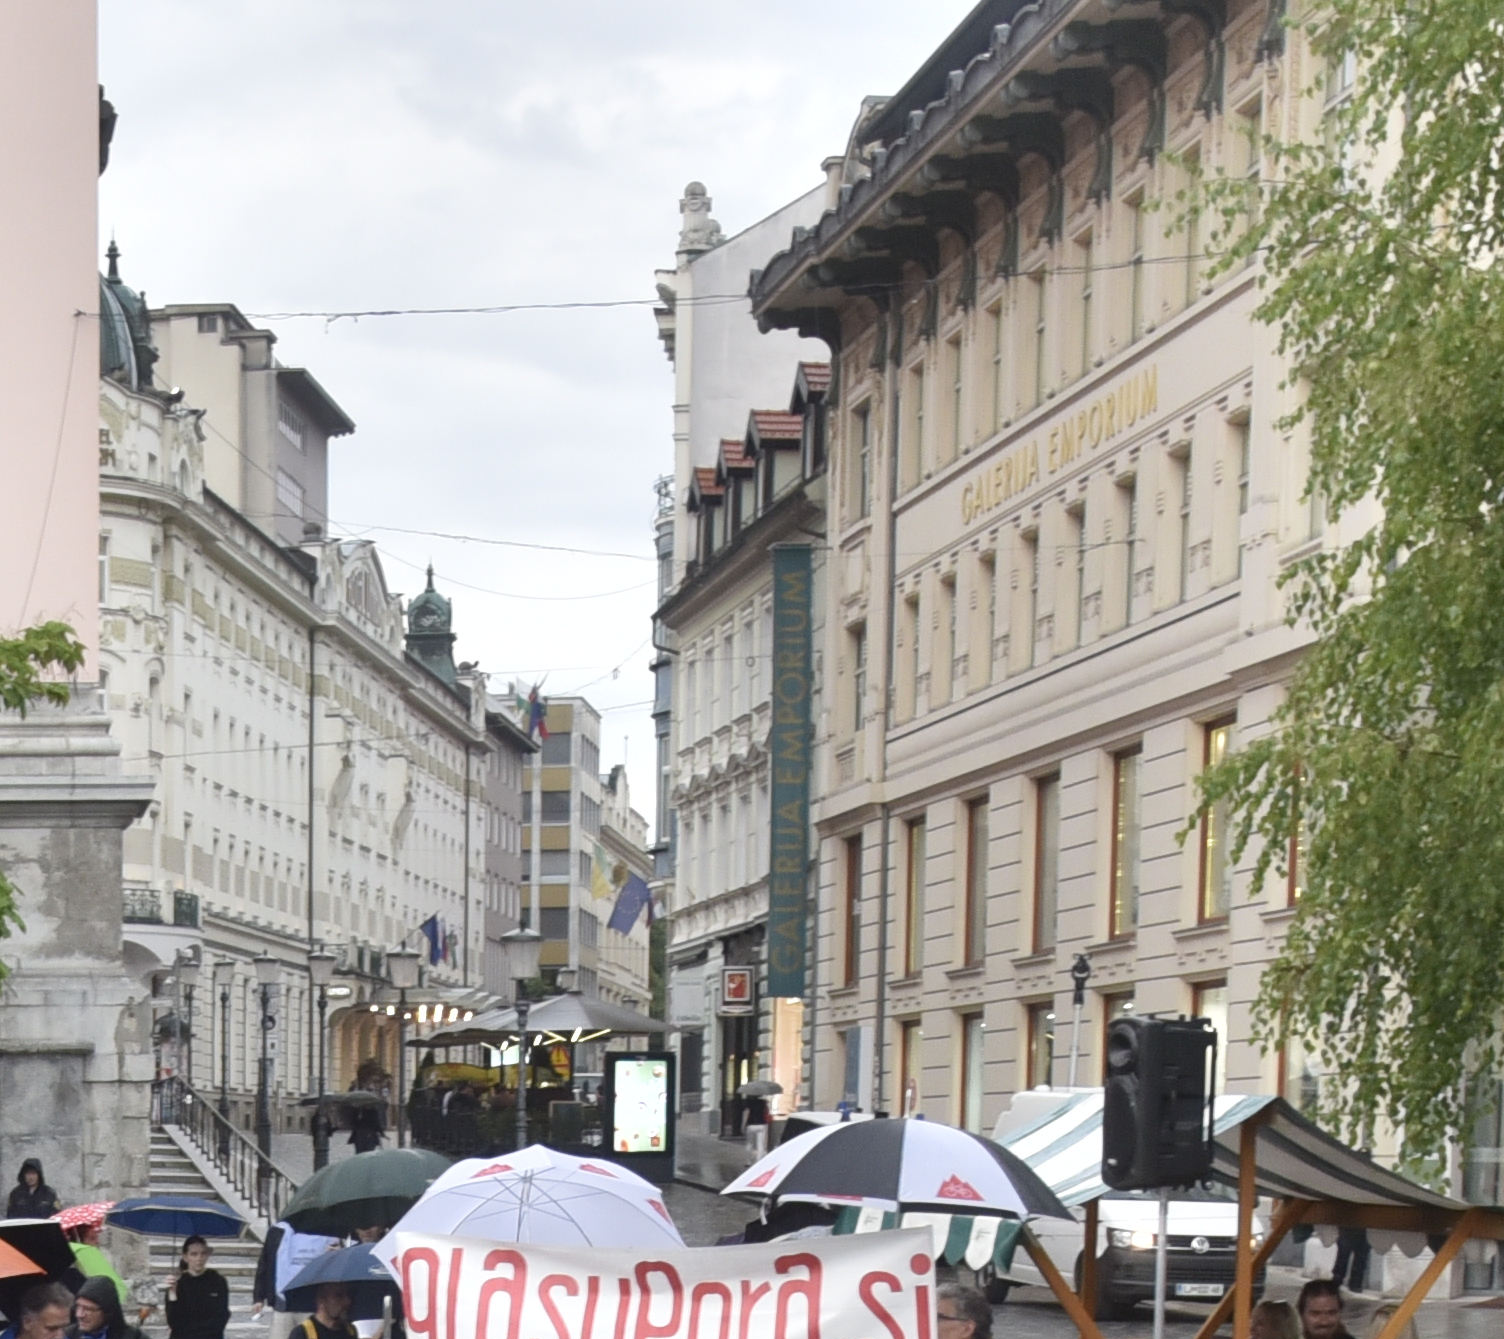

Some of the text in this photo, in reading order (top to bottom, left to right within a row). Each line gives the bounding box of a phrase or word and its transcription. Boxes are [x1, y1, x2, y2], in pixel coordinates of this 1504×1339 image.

[961, 363, 1159, 526] GALERIJA EMPORIUM
[772, 569, 807, 979] GALERIJA EMPORIUM
